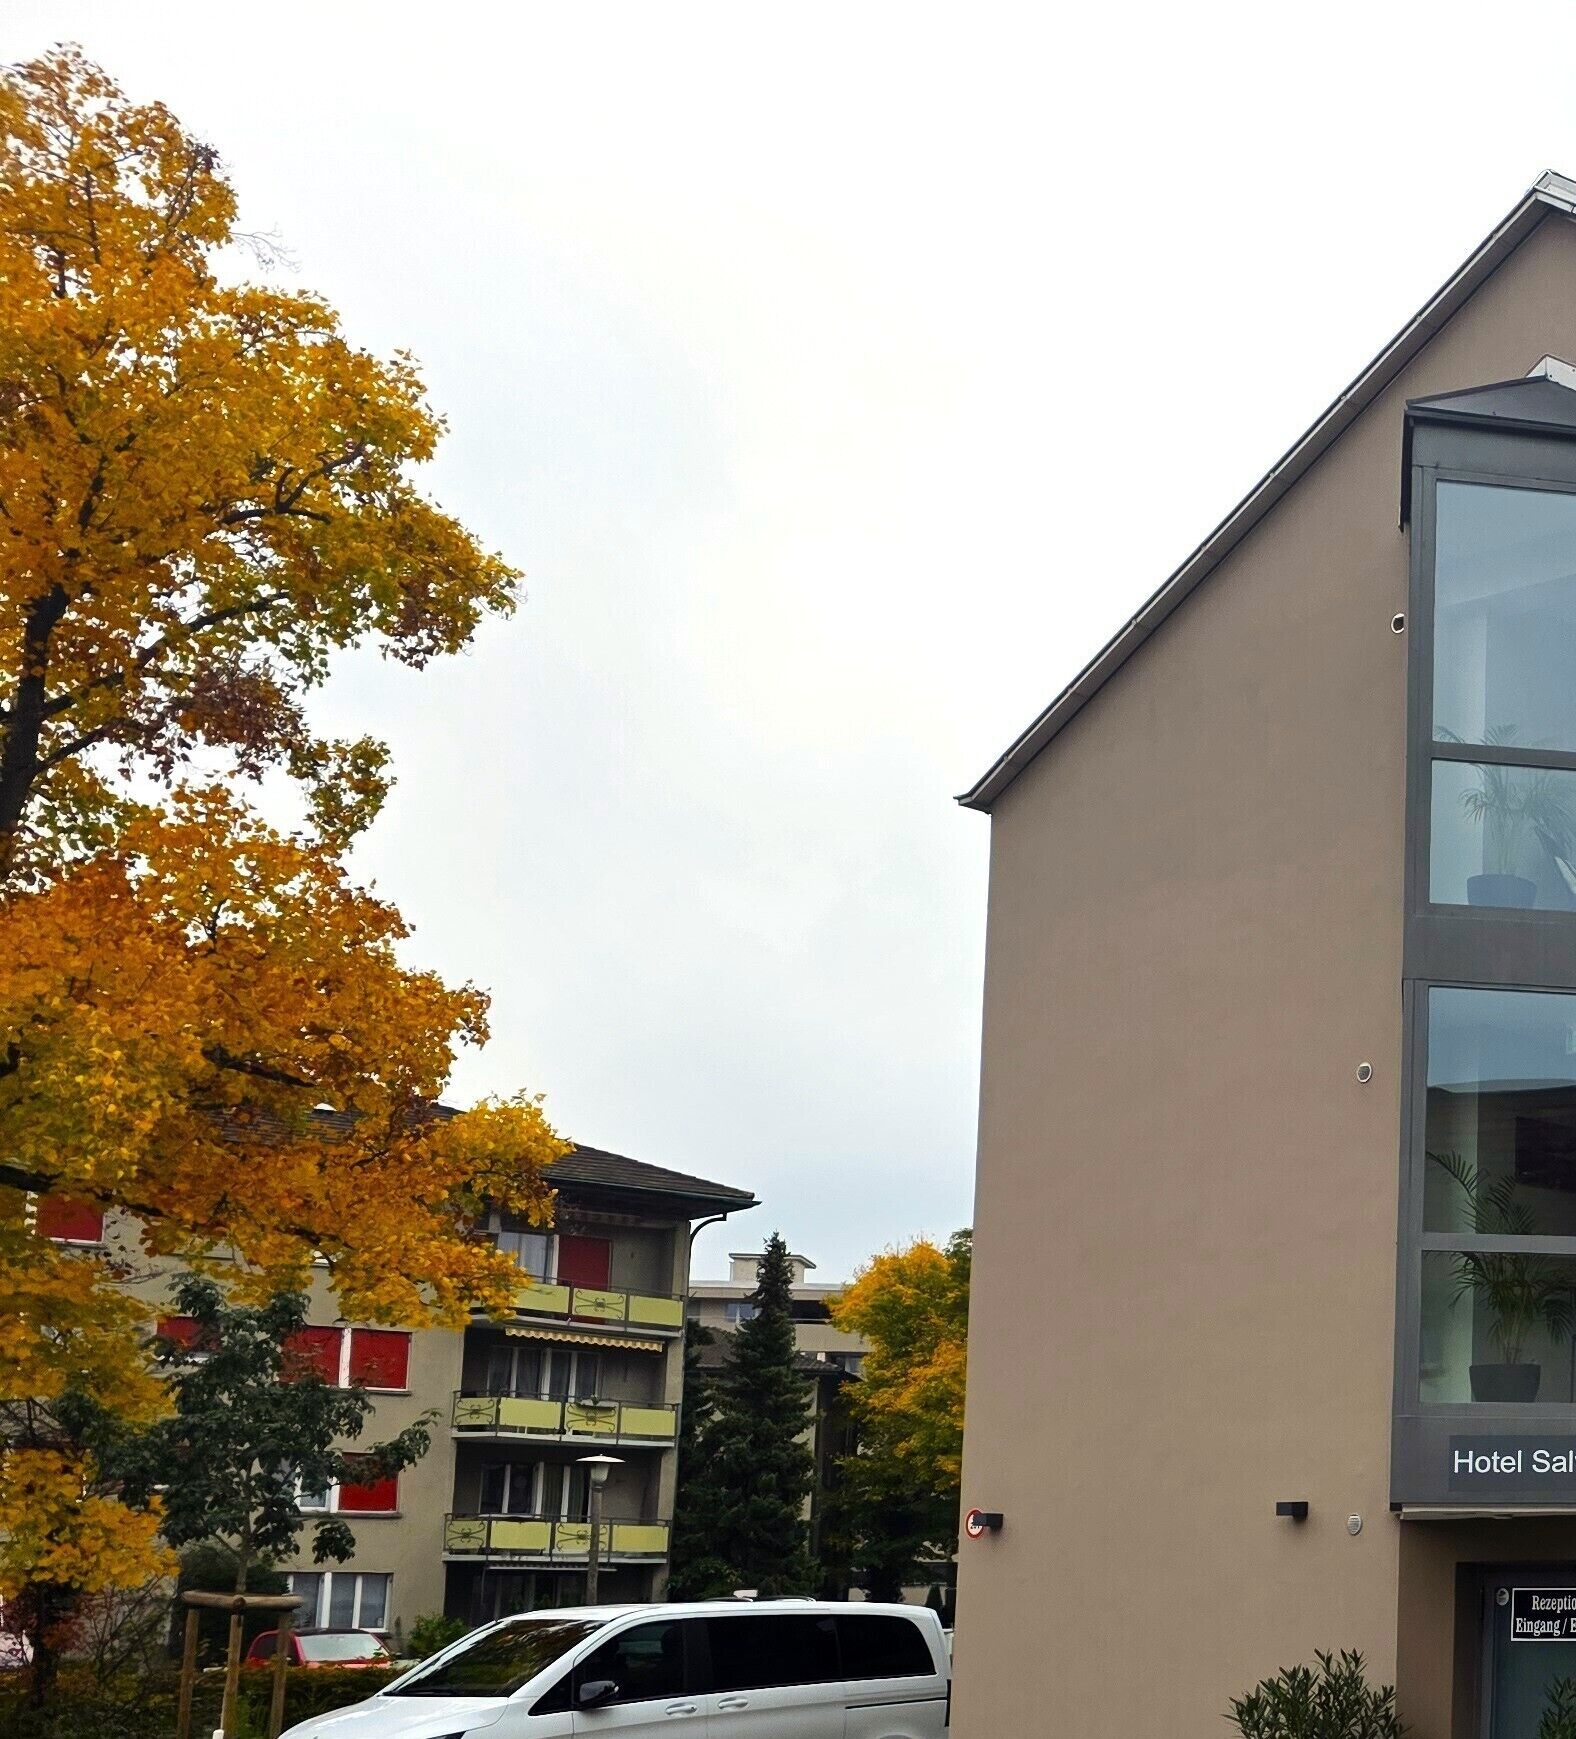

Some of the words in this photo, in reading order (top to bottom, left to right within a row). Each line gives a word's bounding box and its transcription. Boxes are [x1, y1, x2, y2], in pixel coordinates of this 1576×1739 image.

[1454, 1450, 1522, 1473] Hotel
[1515, 1617, 1560, 1636] Eingang
[1562, 1618, 1567, 1634] /
